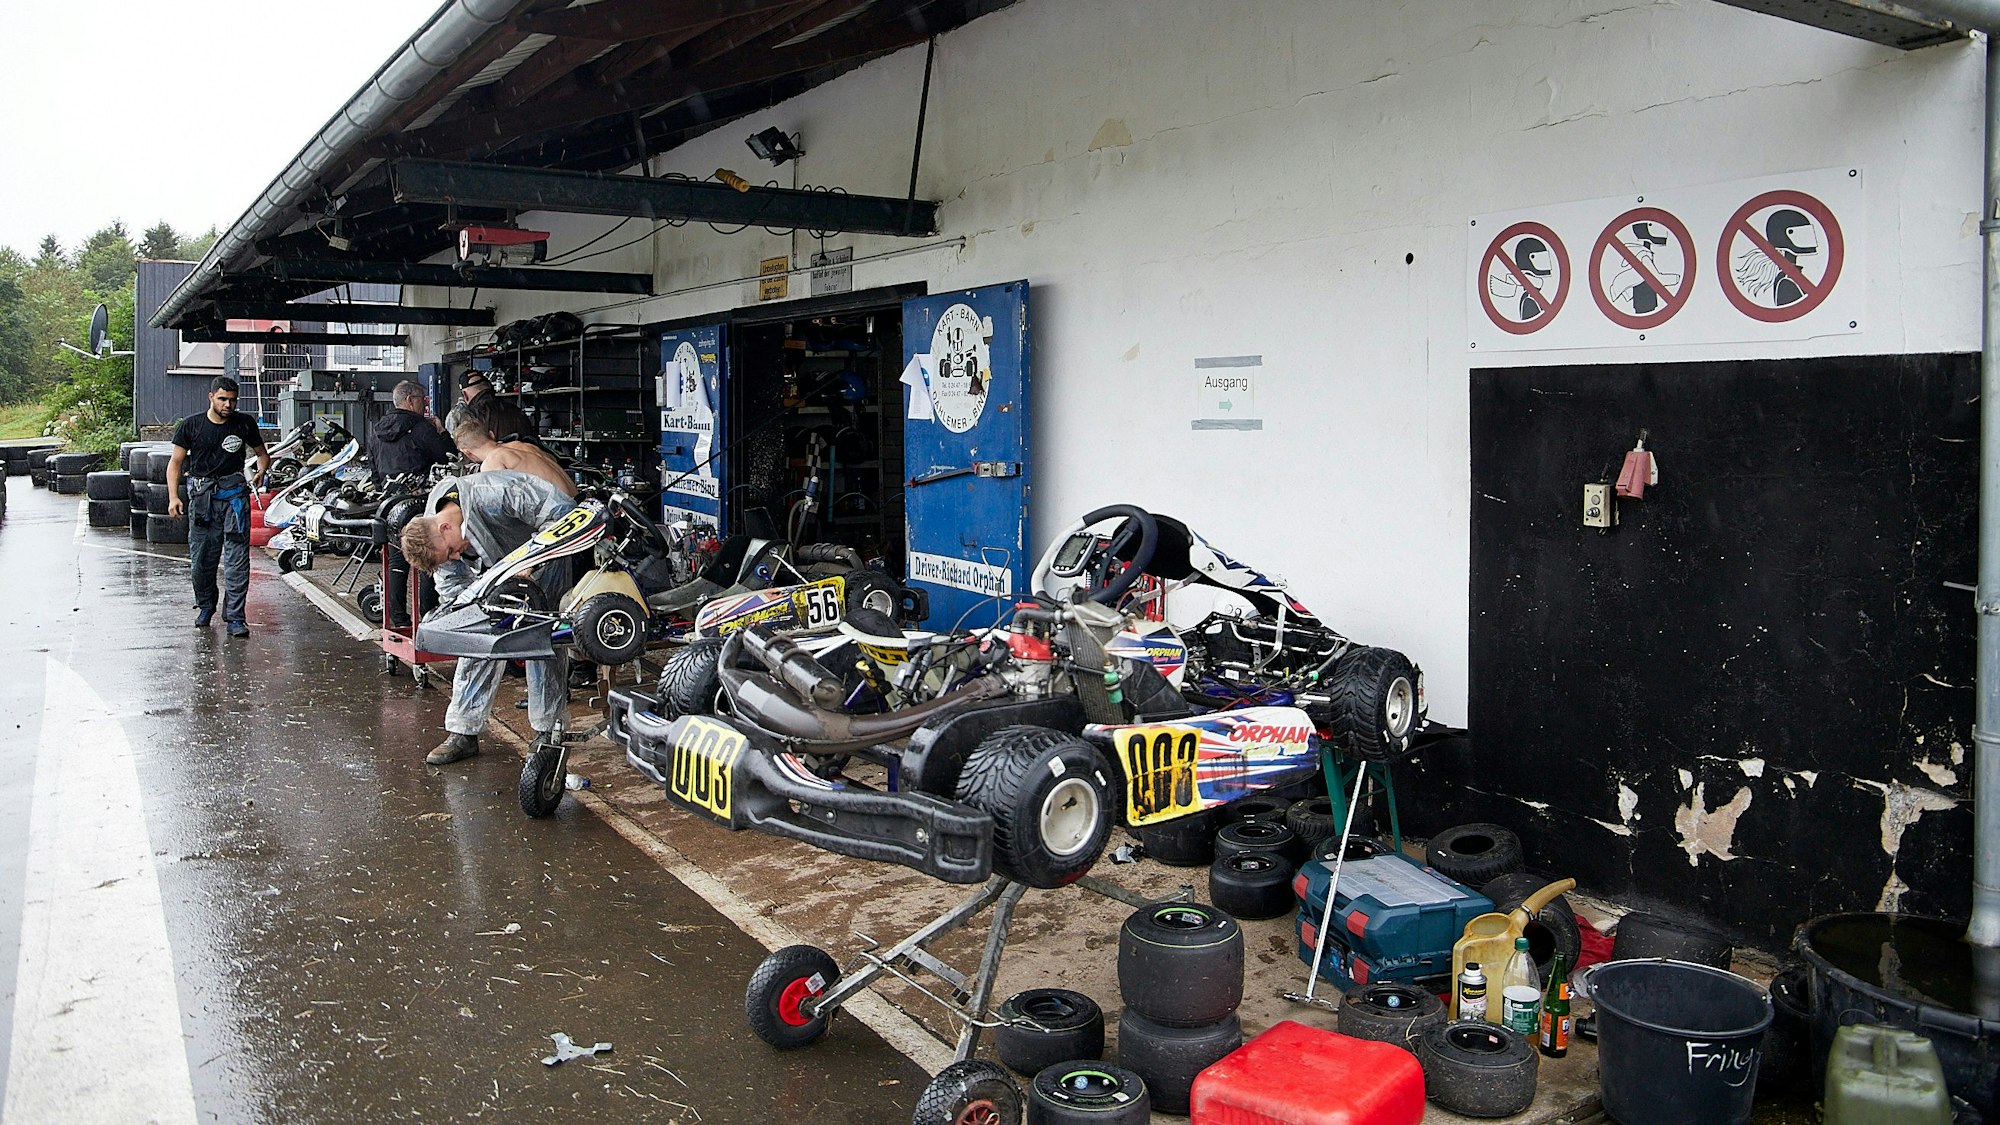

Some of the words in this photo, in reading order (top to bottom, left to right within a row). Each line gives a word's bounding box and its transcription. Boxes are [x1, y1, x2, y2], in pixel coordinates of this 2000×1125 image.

[937, 310, 954, 336] KART
[960, 308, 980, 332] BAHN
[1204, 376, 1248, 391] Ausgang
[932, 391, 968, 428] DAHLEMER
[915, 556, 970, 586] Driver-Richard
[973, 566, 1005, 593] Orphn
[807, 589, 838, 624] 56
[1146, 647, 1182, 657] ORPHAN
[1229, 724, 1310, 744] ORPHAN
[675, 723, 737, 811] 003
